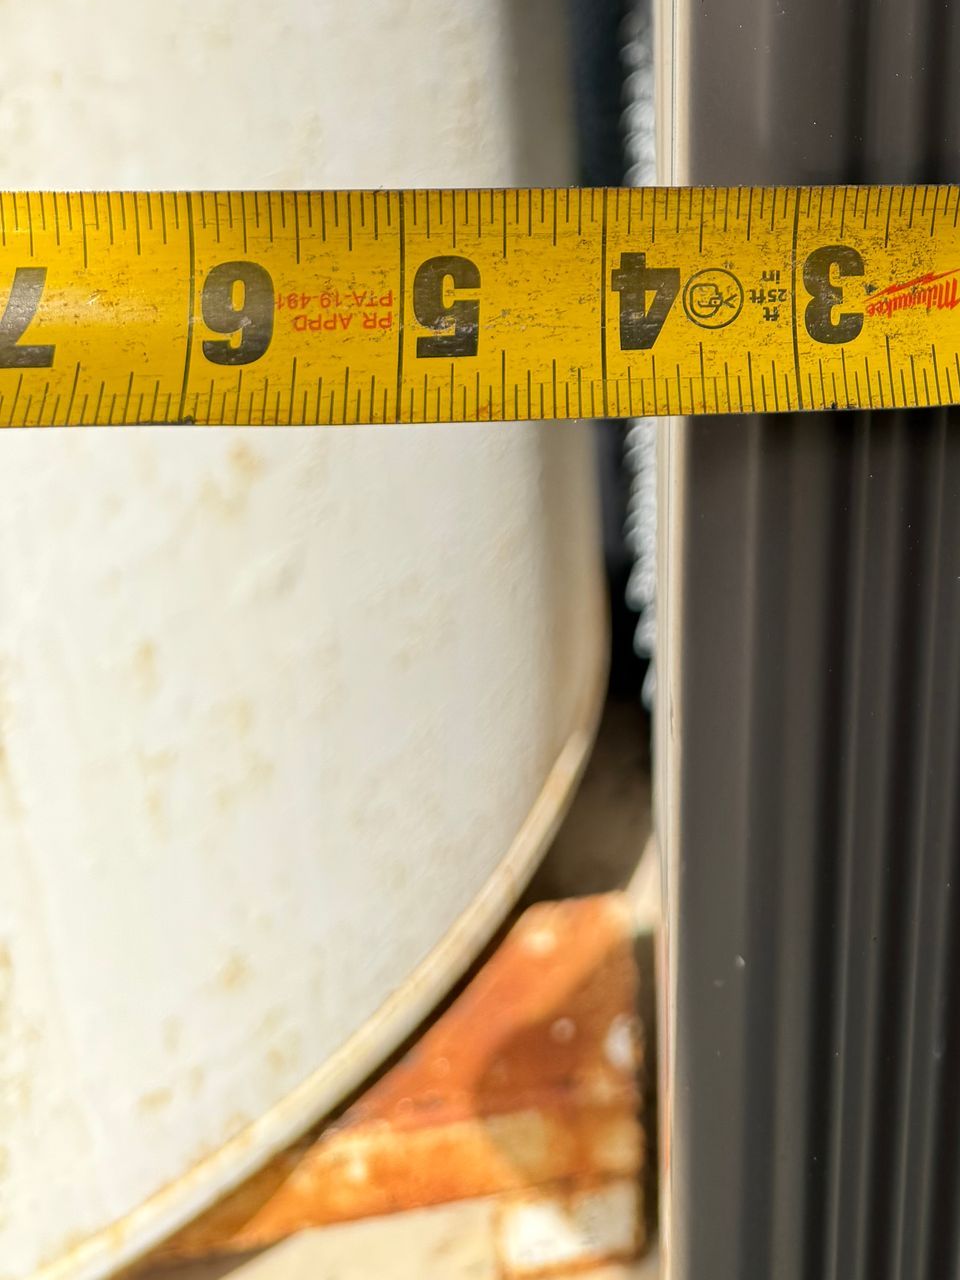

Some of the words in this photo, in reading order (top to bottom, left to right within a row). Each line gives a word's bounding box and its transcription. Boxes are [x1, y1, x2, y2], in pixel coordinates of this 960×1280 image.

[0, 266, 54, 369] 7
[201, 261, 274, 366] 6
[292, 313, 353, 332] APPD
[362, 311, 393, 330] PR
[413, 255, 481, 359] 5
[611, 252, 681, 351] 4
[760, 269, 780, 284] in
[762, 305, 779, 322] ft
[802, 244, 865, 345] 3
